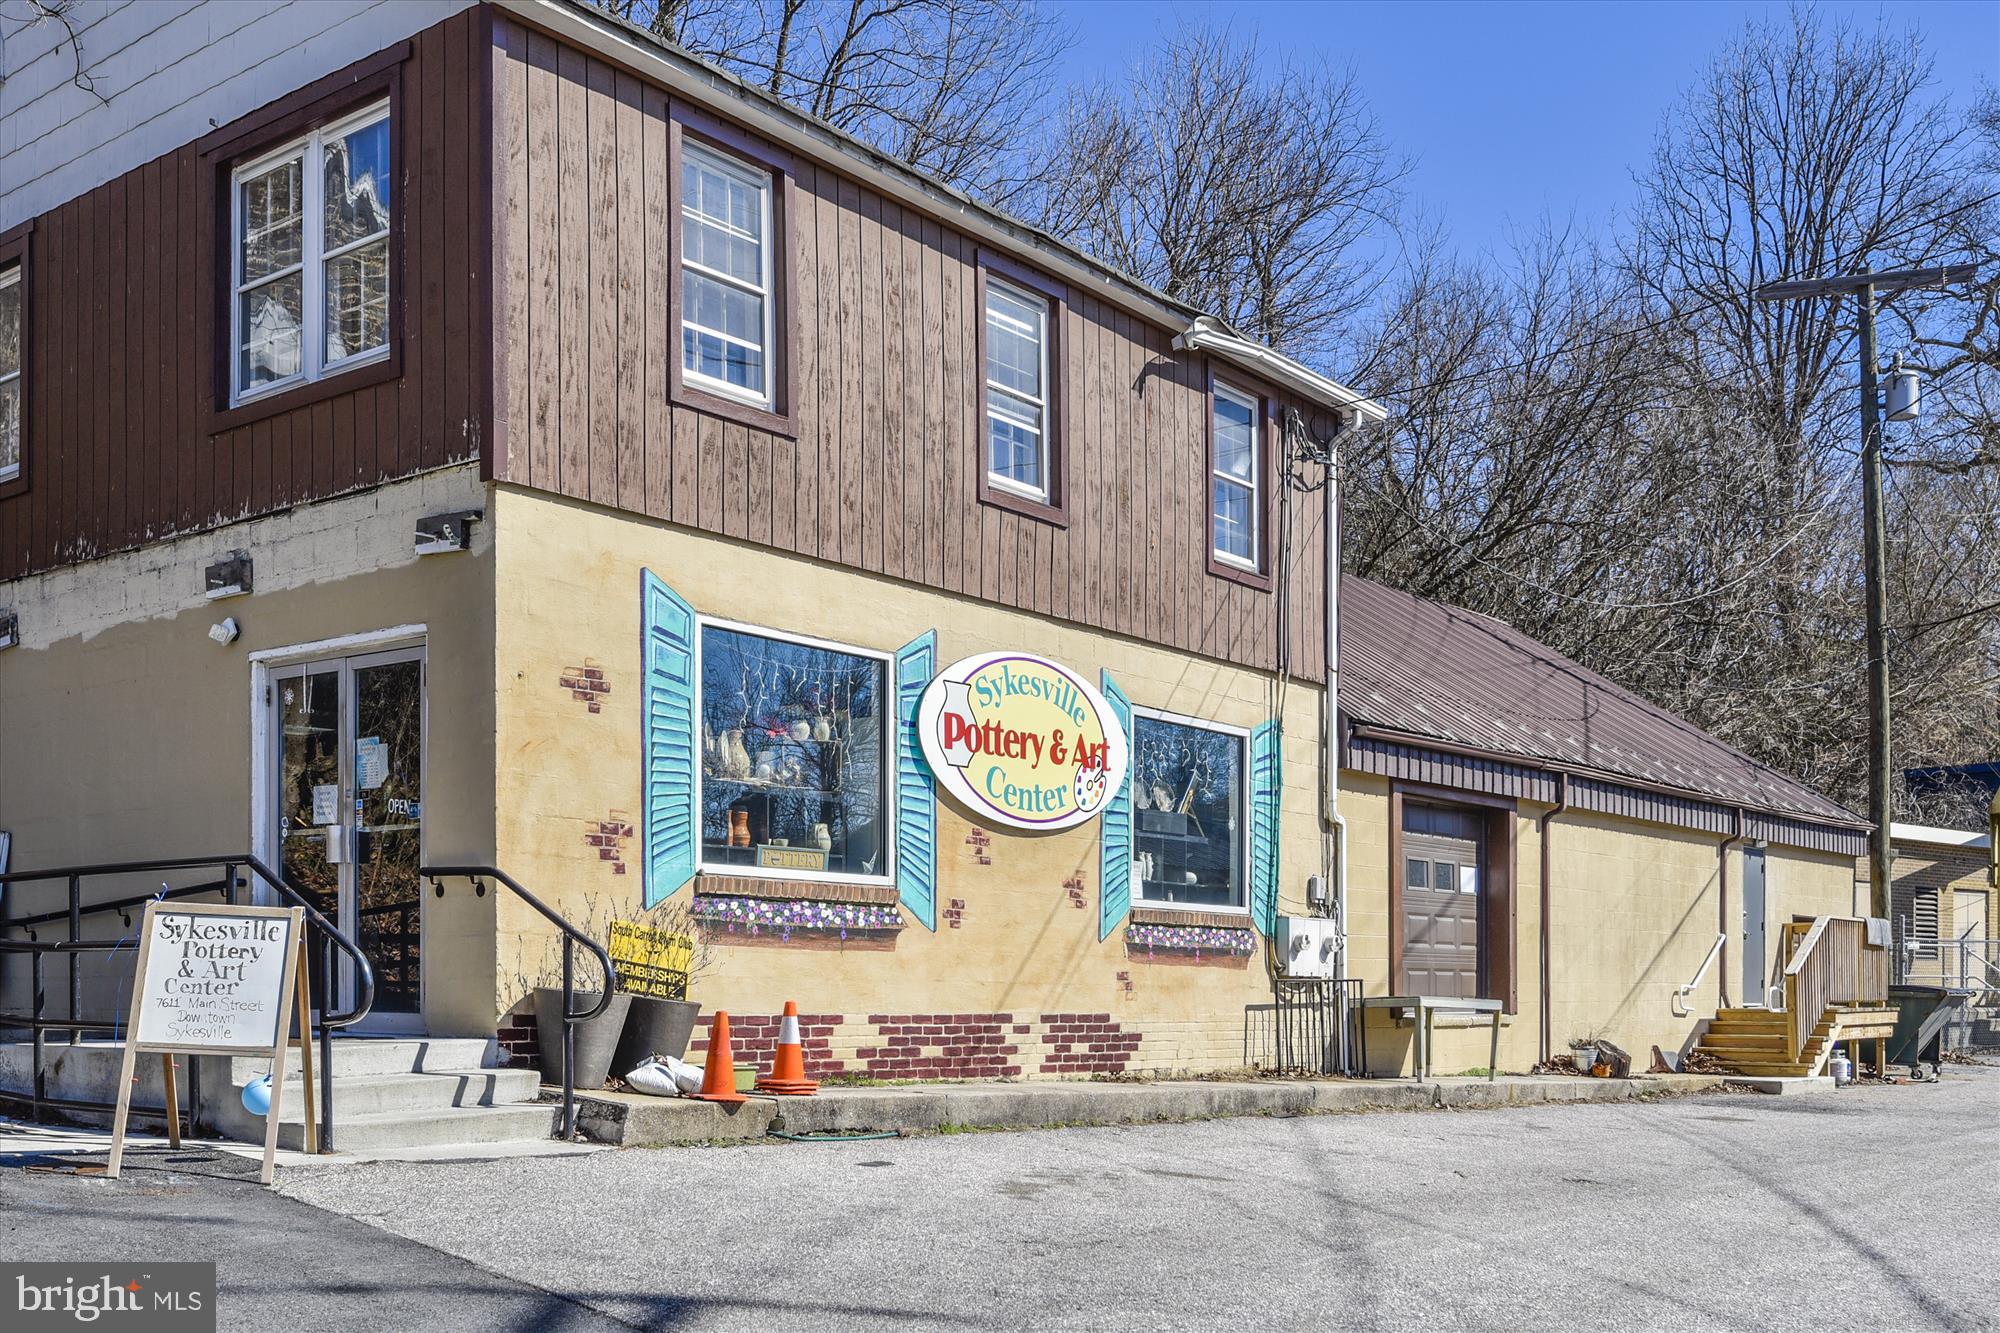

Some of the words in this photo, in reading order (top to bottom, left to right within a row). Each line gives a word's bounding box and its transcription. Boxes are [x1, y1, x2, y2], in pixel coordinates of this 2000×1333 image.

[975, 664, 1086, 728] Sykesville
[943, 712, 1045, 769] Pottery
[1049, 729, 1068, 765] &
[1071, 733, 1111, 772] Art
[985, 766, 1068, 814] Center
[387, 798, 411, 815] OPEN
[159, 915, 281, 944] Sykesville
[612, 921, 633, 937] South
[182, 941, 263, 963] Pottery
[178, 959, 194, 978] &
[201, 960, 248, 981] Art
[164, 977, 240, 995] Center
[188, 998, 217, 1009] Main
[219, 997, 265, 1012] Street
[177, 1010, 236, 1024] Dowtown
[165, 1022, 233, 1041] Sykesville
